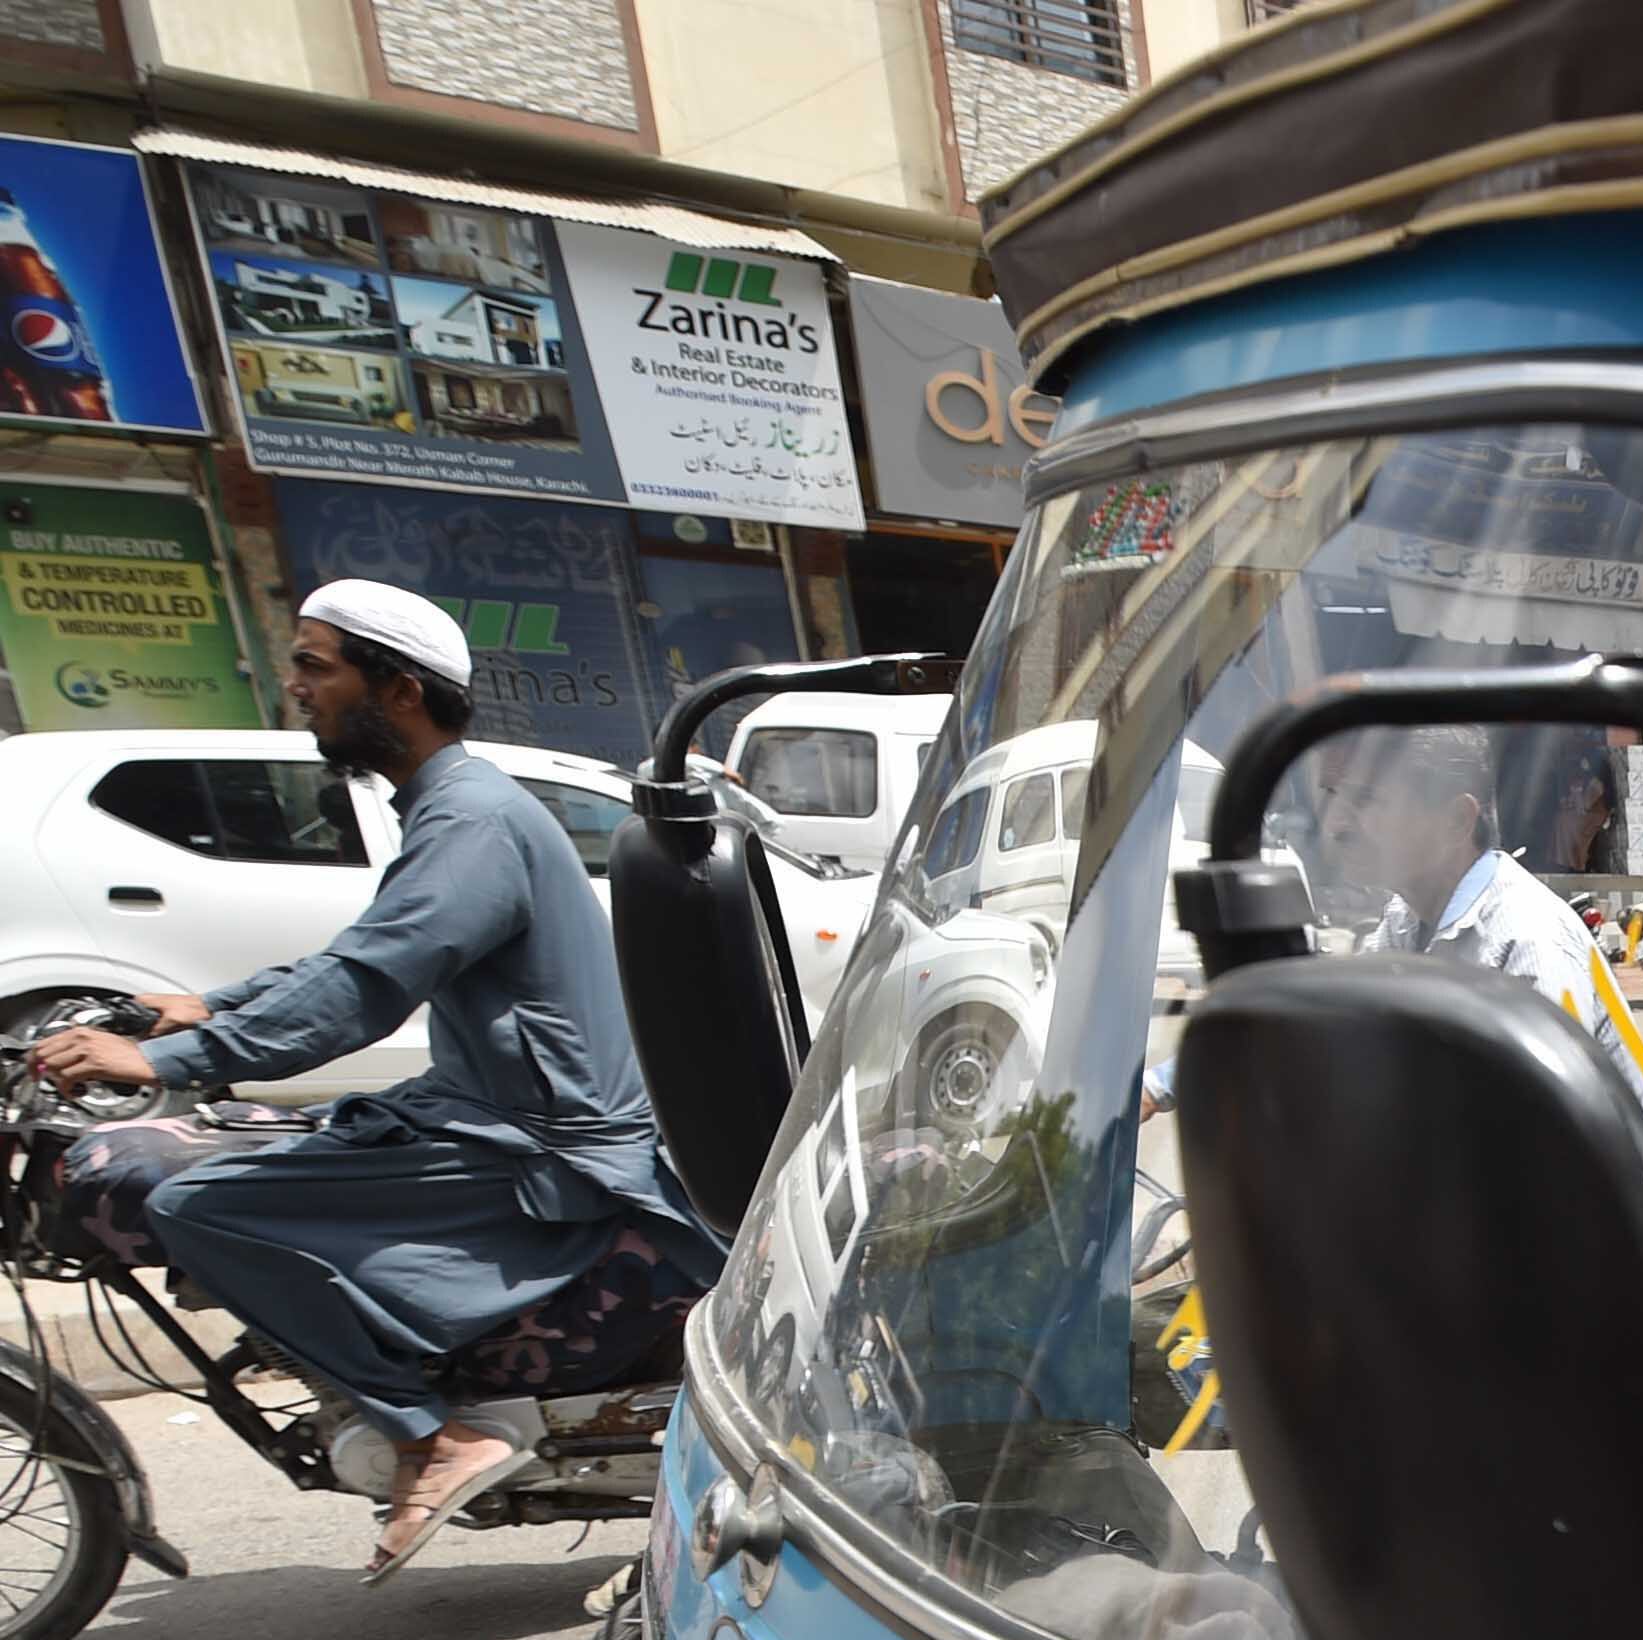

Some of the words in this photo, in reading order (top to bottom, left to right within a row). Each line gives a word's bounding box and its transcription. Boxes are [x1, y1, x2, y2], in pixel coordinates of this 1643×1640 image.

[632, 288, 820, 354] Zarina's
[678, 342, 722, 365] Real
[726, 349, 785, 374] Estate
[631, 356, 646, 375] &
[650, 360, 727, 386] Interior
[731, 371, 839, 401] Decorators
[784, 400, 823, 417] Agent
[251, 430, 293, 448] Shop
[321, 436, 352, 452] Plot
[414, 446, 466, 464] Usman
[467, 452, 515, 469] Corner
[347, 457, 384, 472] Near
[10, 529, 56, 550] BUY
[61, 533, 184, 559] AUTHENTIC
[18, 562, 34, 579] &
[37, 562, 192, 588] TEMPERATURE
[21, 587, 206, 618] CONTROLLED
[57, 619, 157, 638] MEDICINES
[159, 623, 184, 639] AT
